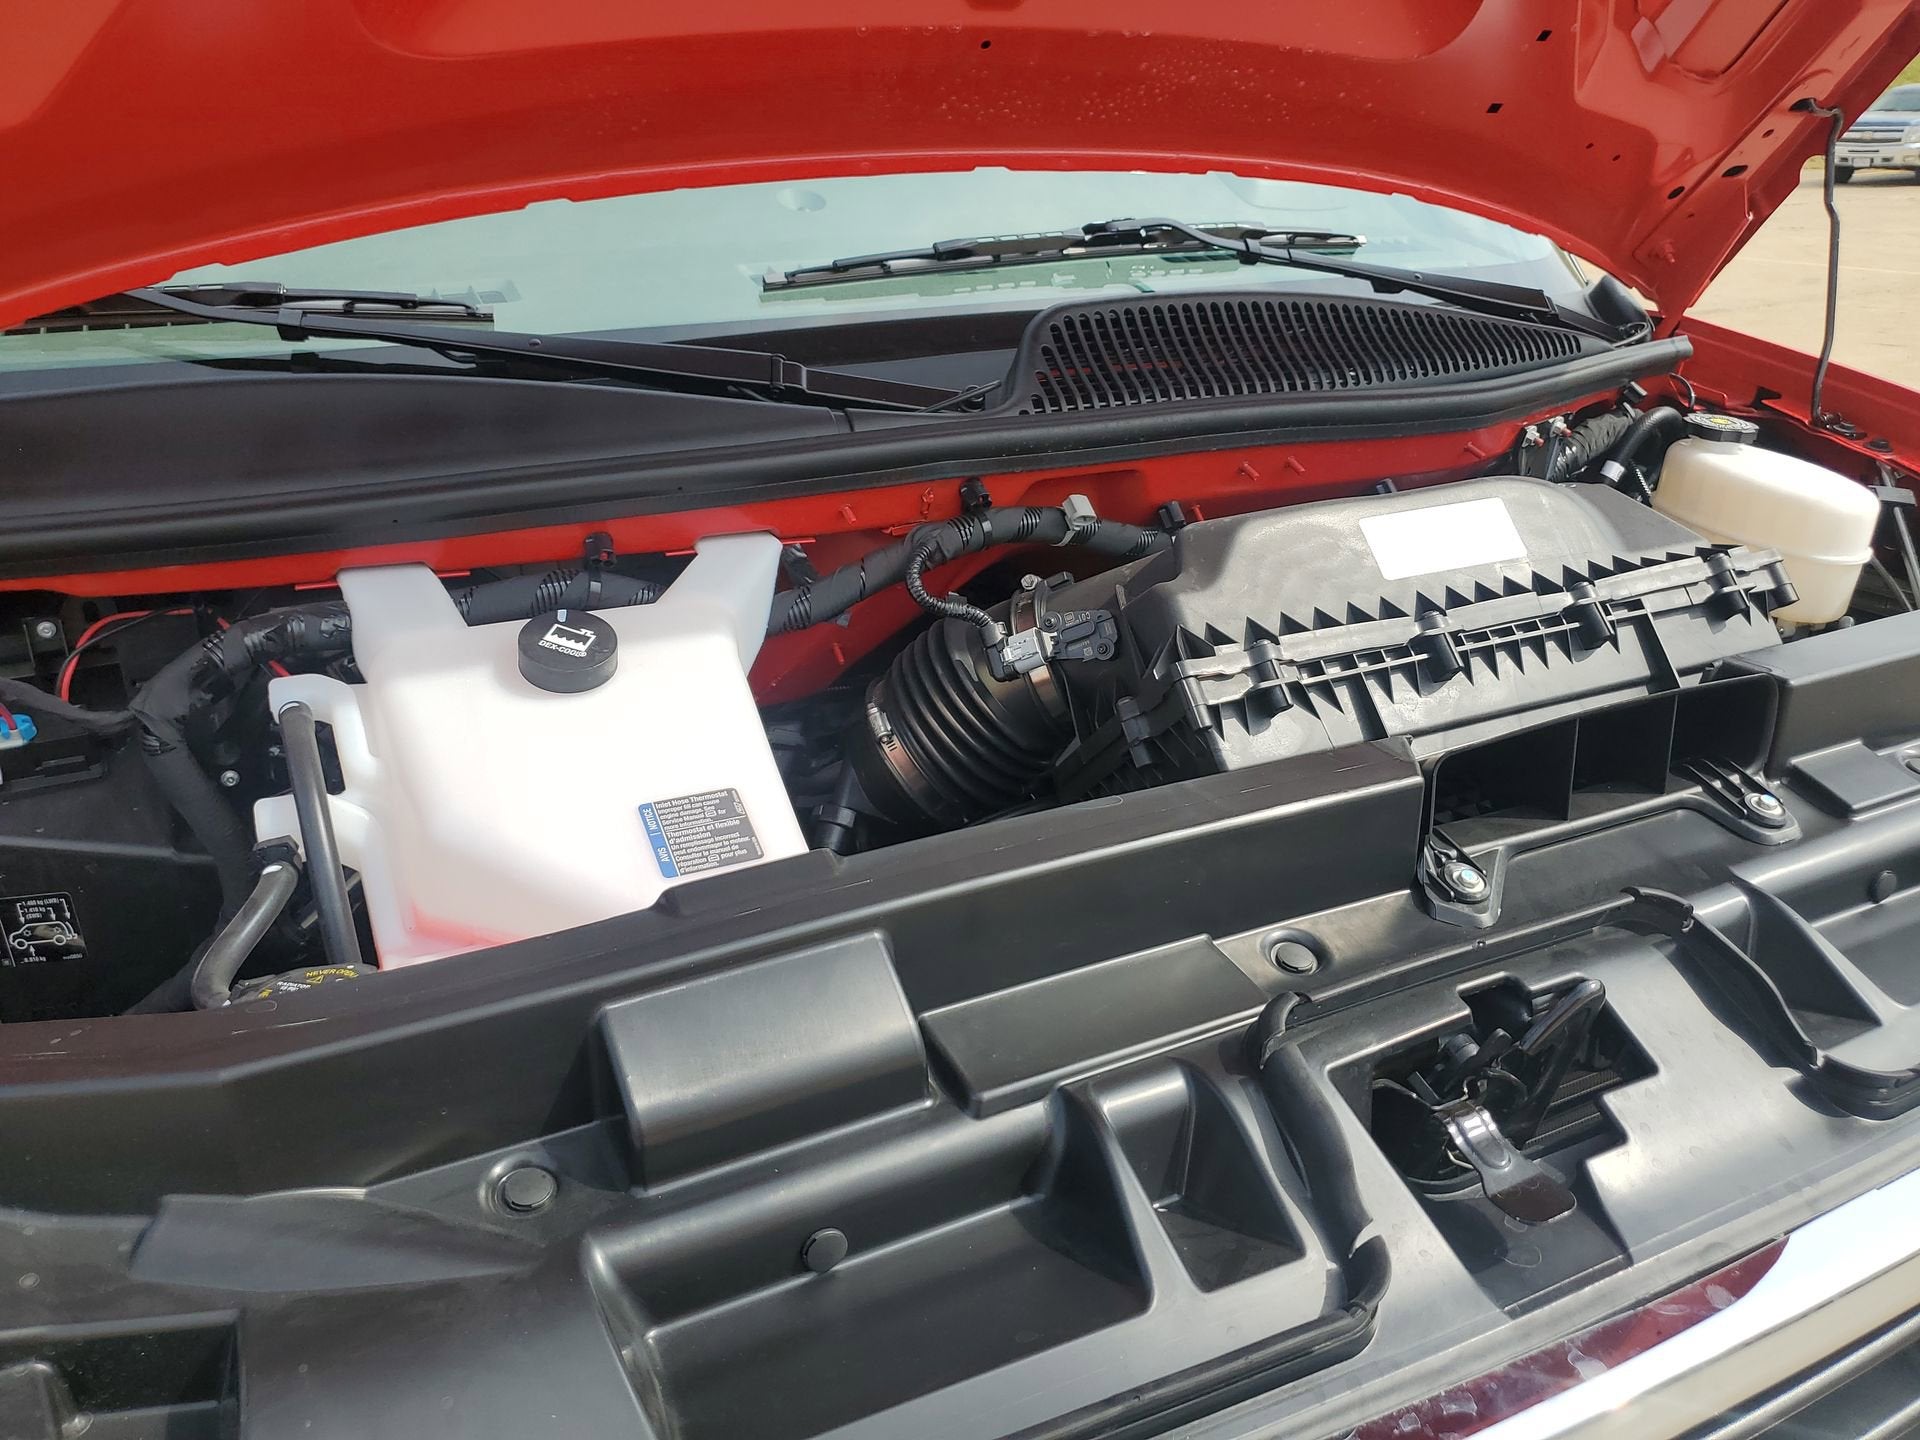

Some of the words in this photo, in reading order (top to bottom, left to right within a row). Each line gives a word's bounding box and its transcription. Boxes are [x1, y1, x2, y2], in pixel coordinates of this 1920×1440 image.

[672, 798, 689, 806] Hose
[689, 790, 728, 803] Thermostat
[643, 807, 657, 830] NOTICE
[661, 818, 683, 826] Service
[680, 817, 713, 828] information.
[667, 826, 706, 838] Thermostat
[715, 819, 740, 828] flexible
[670, 832, 711, 844] d'admission
[657, 847, 670, 862] AVIS
[306, 968, 336, 977] NEVER
[277, 981, 311, 989] RADIATOR
